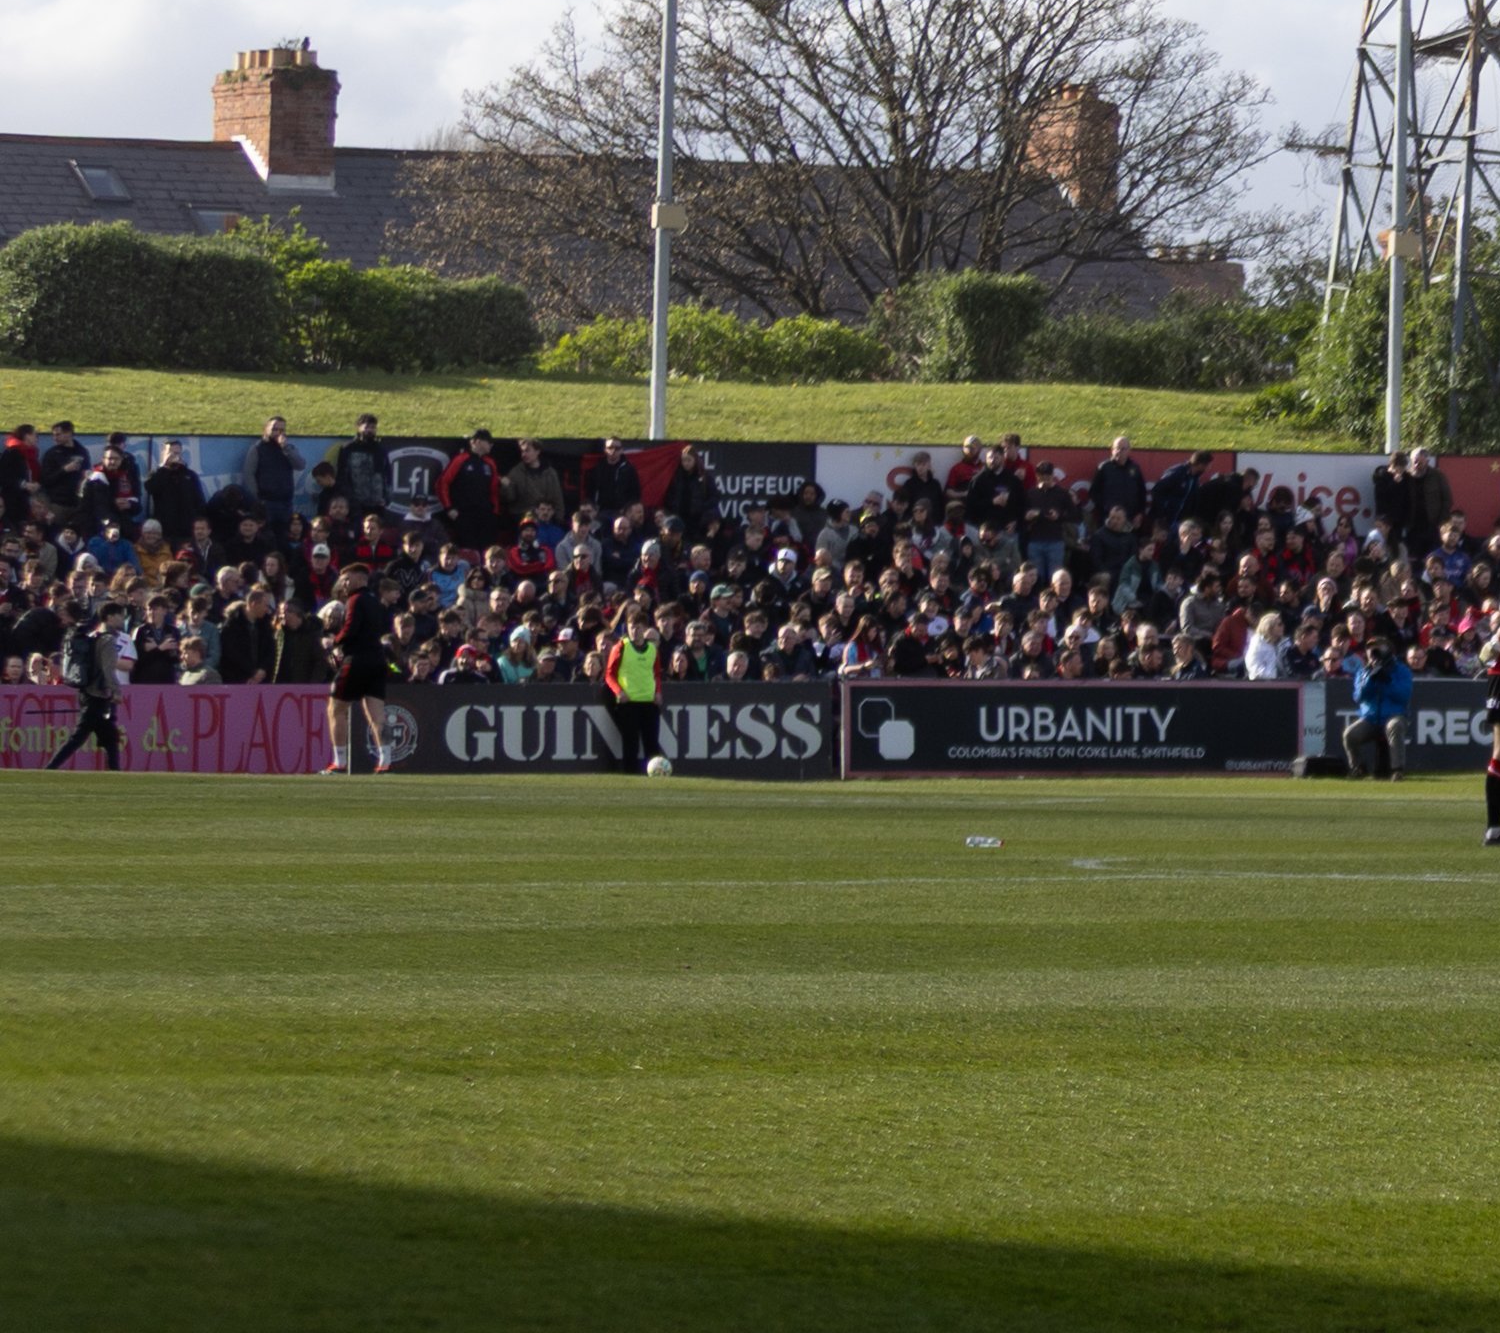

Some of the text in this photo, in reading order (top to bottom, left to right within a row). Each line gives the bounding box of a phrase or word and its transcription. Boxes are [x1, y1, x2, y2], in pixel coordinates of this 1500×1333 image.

[147, 691, 177, 773] A
[979, 706, 1176, 743] URBANITY
[948, 745, 1206, 760] COLOMBIA'S FINEST ON COKE LANE, SMITHFIELD
